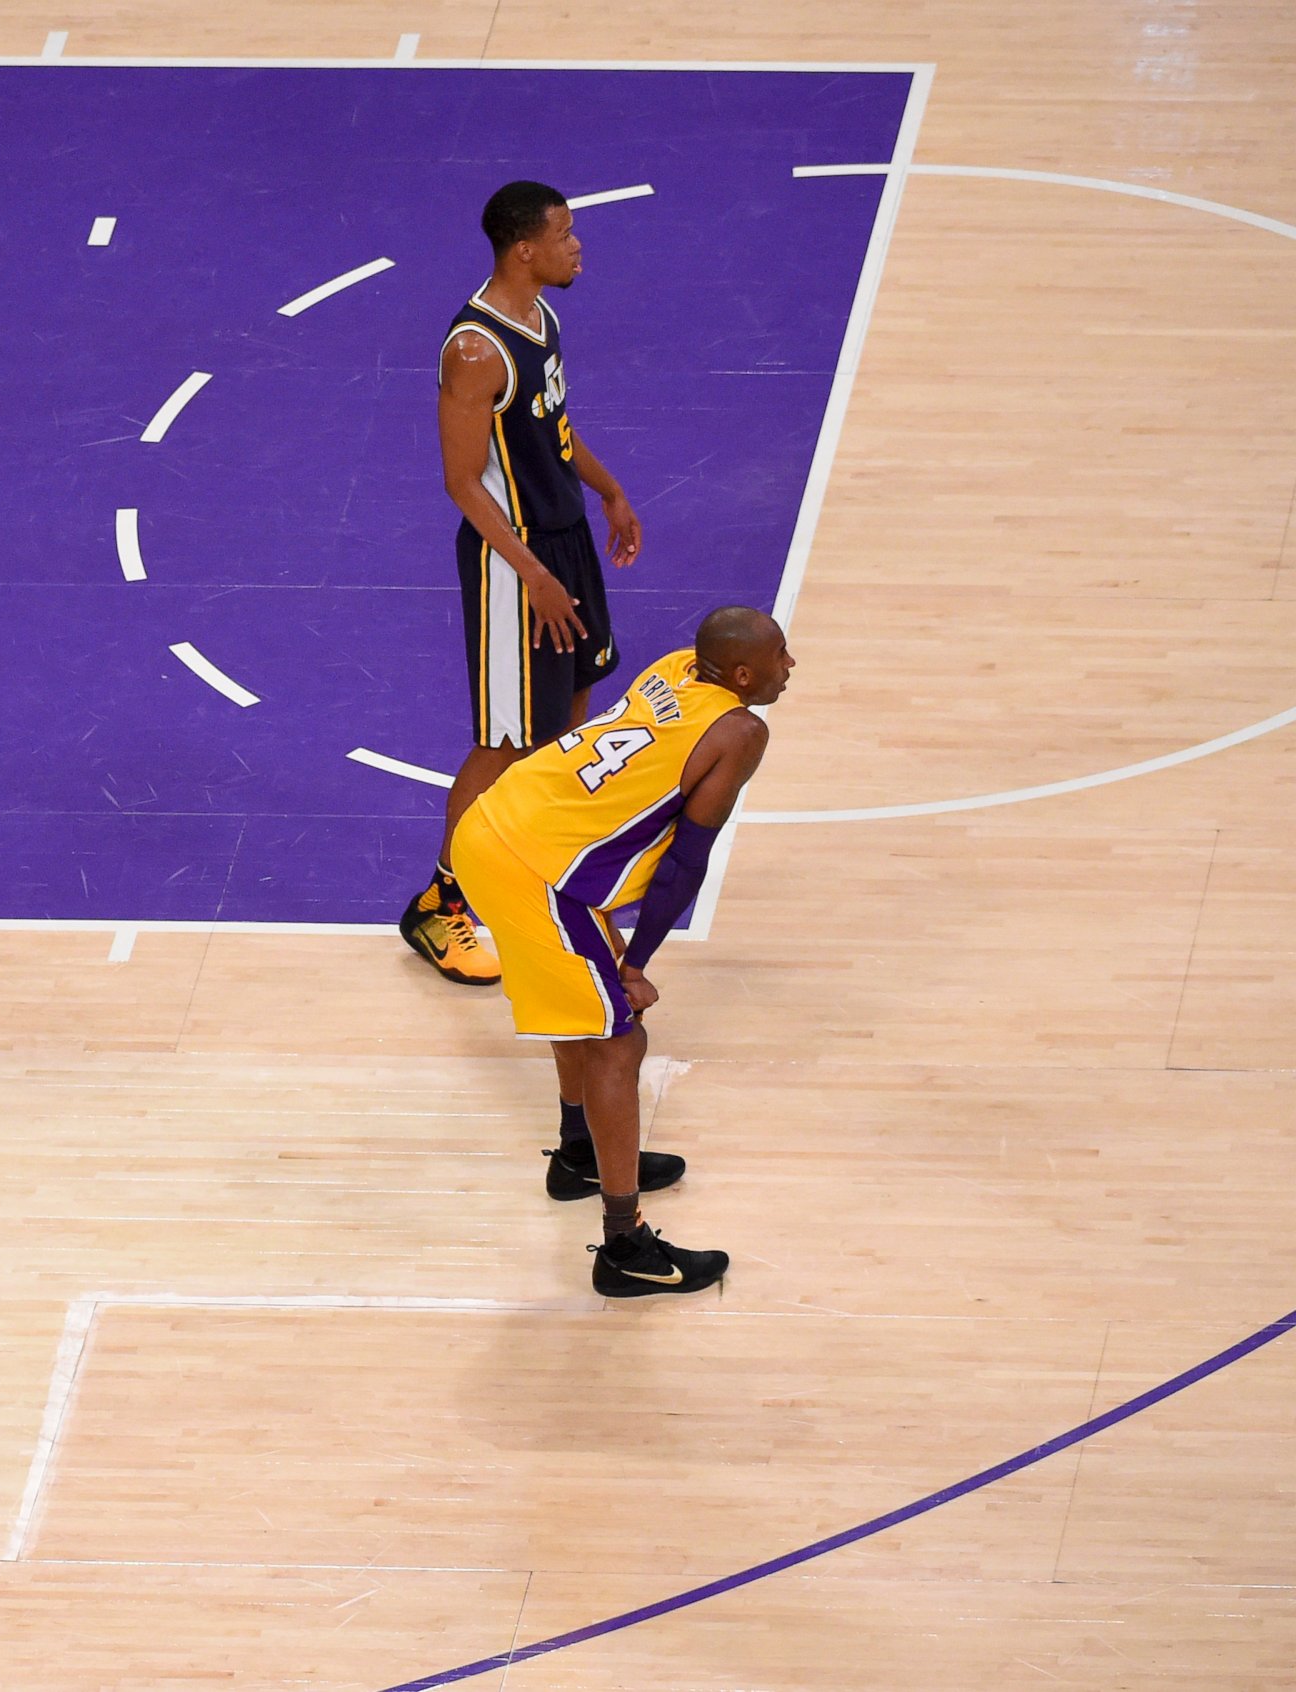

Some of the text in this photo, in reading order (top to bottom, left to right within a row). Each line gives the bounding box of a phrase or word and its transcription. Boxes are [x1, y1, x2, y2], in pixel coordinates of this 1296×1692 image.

[557, 412, 573, 462] 5
[637, 674, 681, 725] BRYANT
[556, 697, 656, 795] 24
